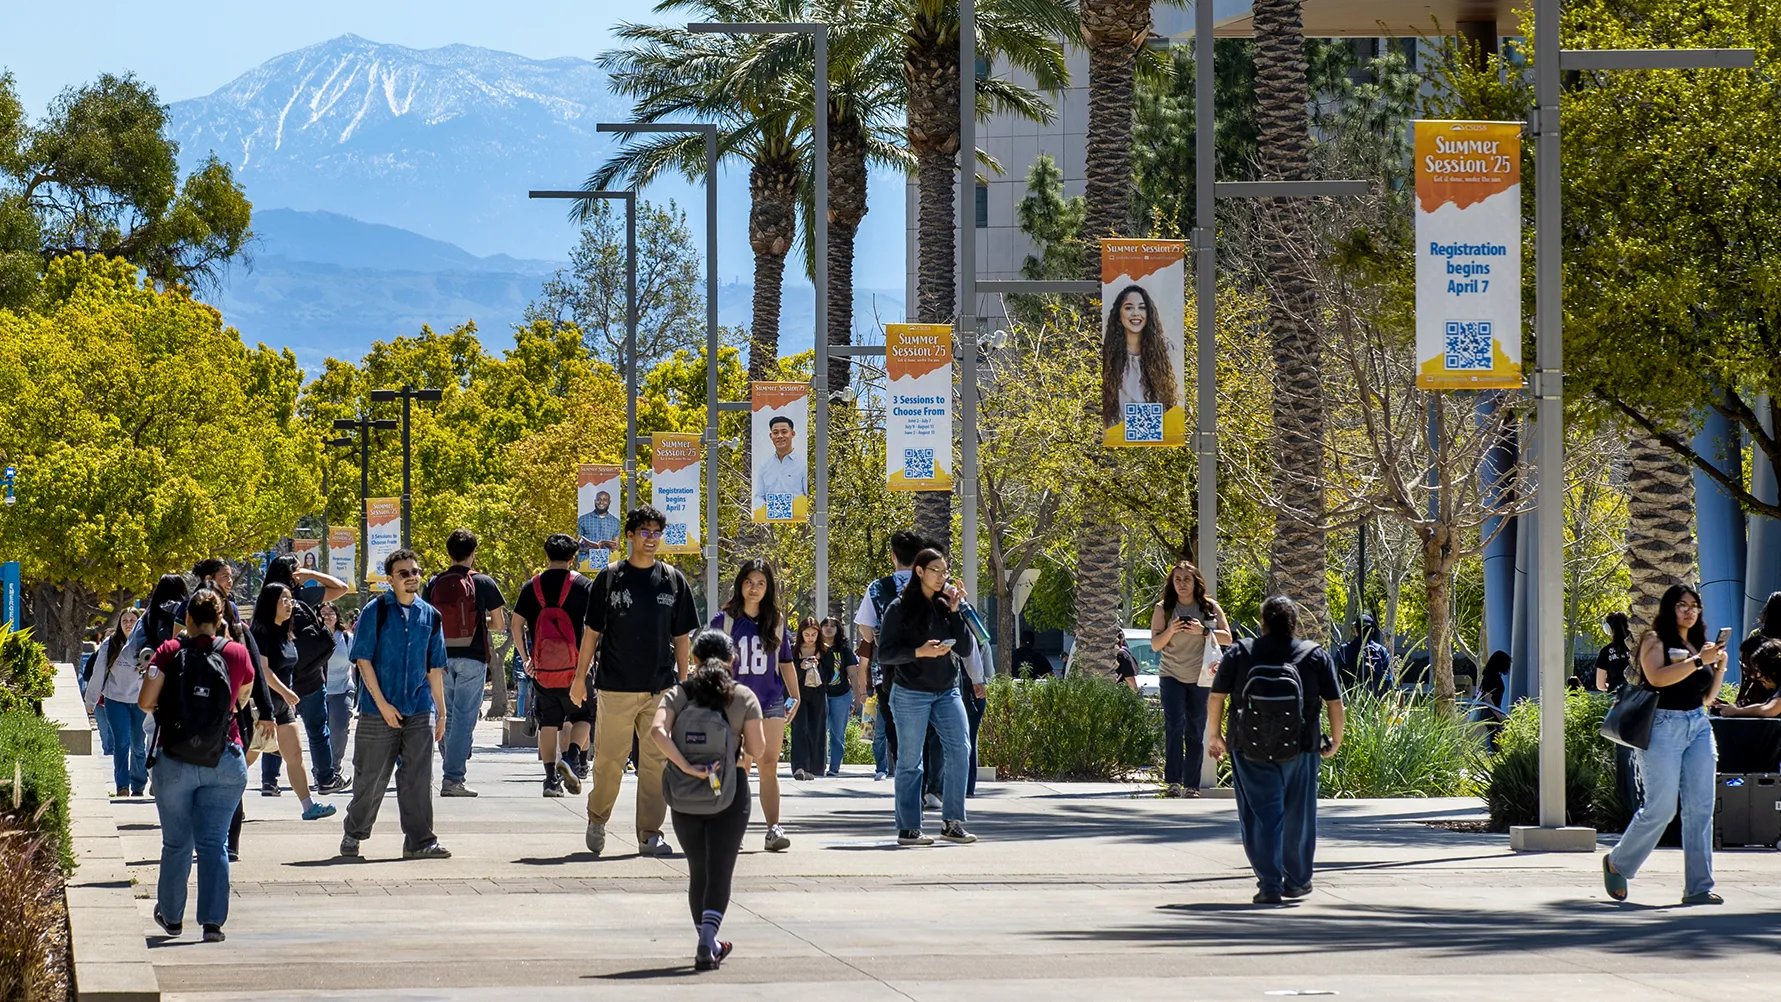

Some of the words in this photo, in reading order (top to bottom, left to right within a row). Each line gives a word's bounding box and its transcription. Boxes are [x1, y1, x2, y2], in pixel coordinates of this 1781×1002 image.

[1435, 135, 1499, 154] Summer
[1424, 154, 1490, 173] Session
[1490, 155, 1511, 173] '25
[1106, 243, 1139, 253] Summer
[1141, 243, 1170, 253] Session
[1430, 241, 1507, 259] Registration
[1446, 260, 1490, 278] begins
[1447, 279, 1478, 296] April
[1481, 280, 1489, 293] 7
[898, 332, 939, 345] Summer
[892, 344, 932, 357] Session
[932, 344, 946, 357] '25
[893, 395, 898, 404] 3
[900, 394, 935, 404] Sessions
[935, 395, 945, 404] to
[893, 406, 922, 416] Choose
[923, 406, 945, 416] From
[661, 439, 691, 448] Summer
[656, 447, 685, 456] Session
[658, 487, 694, 496] Registration
[665, 495, 686, 504] begins
[666, 504, 680, 512] April
[738, 635, 768, 675] 18
